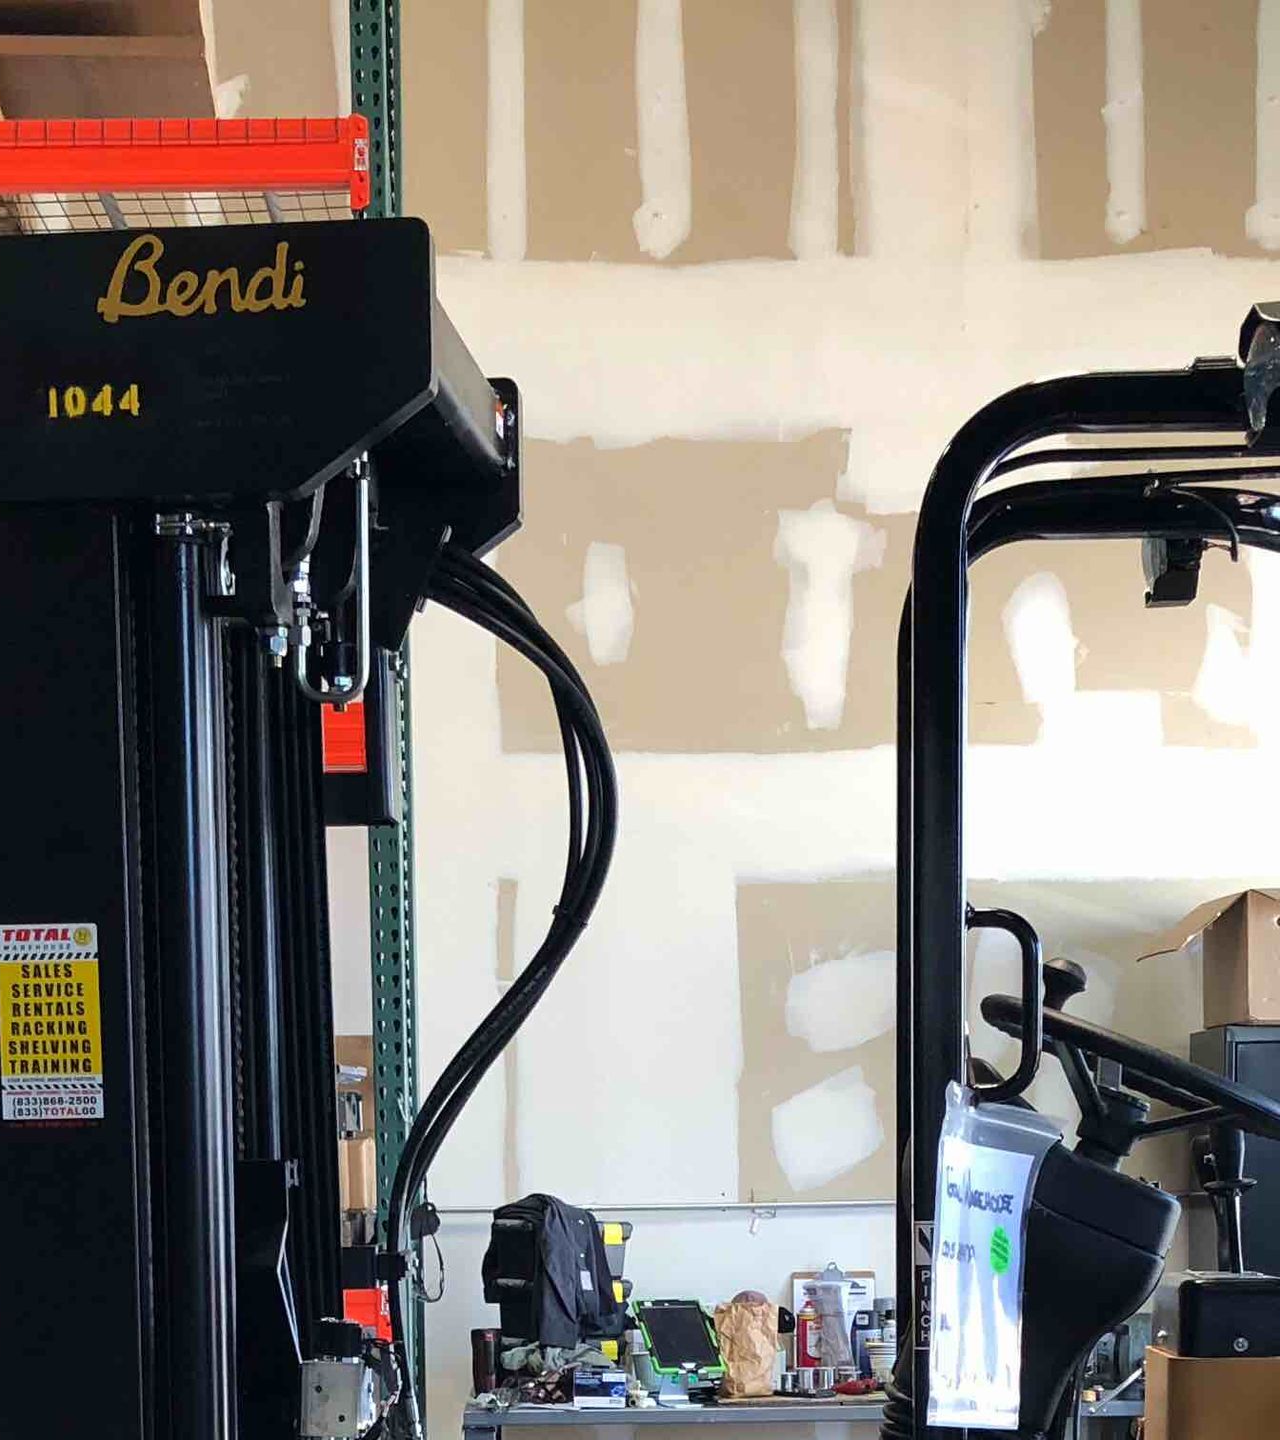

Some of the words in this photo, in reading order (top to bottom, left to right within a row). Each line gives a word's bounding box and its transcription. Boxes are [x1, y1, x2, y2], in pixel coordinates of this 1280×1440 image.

[97, 234, 307, 323] Bendi
[47, 383, 141, 419] 1044
[2, 928, 71, 942] TOTAL
[21, 964, 73, 979] SALES
[11, 983, 85, 998] SERVICE
[12, 1002, 85, 1018] RENTALS
[11, 1021, 88, 1036] RACKING
[8, 1040, 91, 1055] SHELVING
[9, 1059, 92, 1074] TRAINING
[921, 1270, 931, 1342] PINCH
